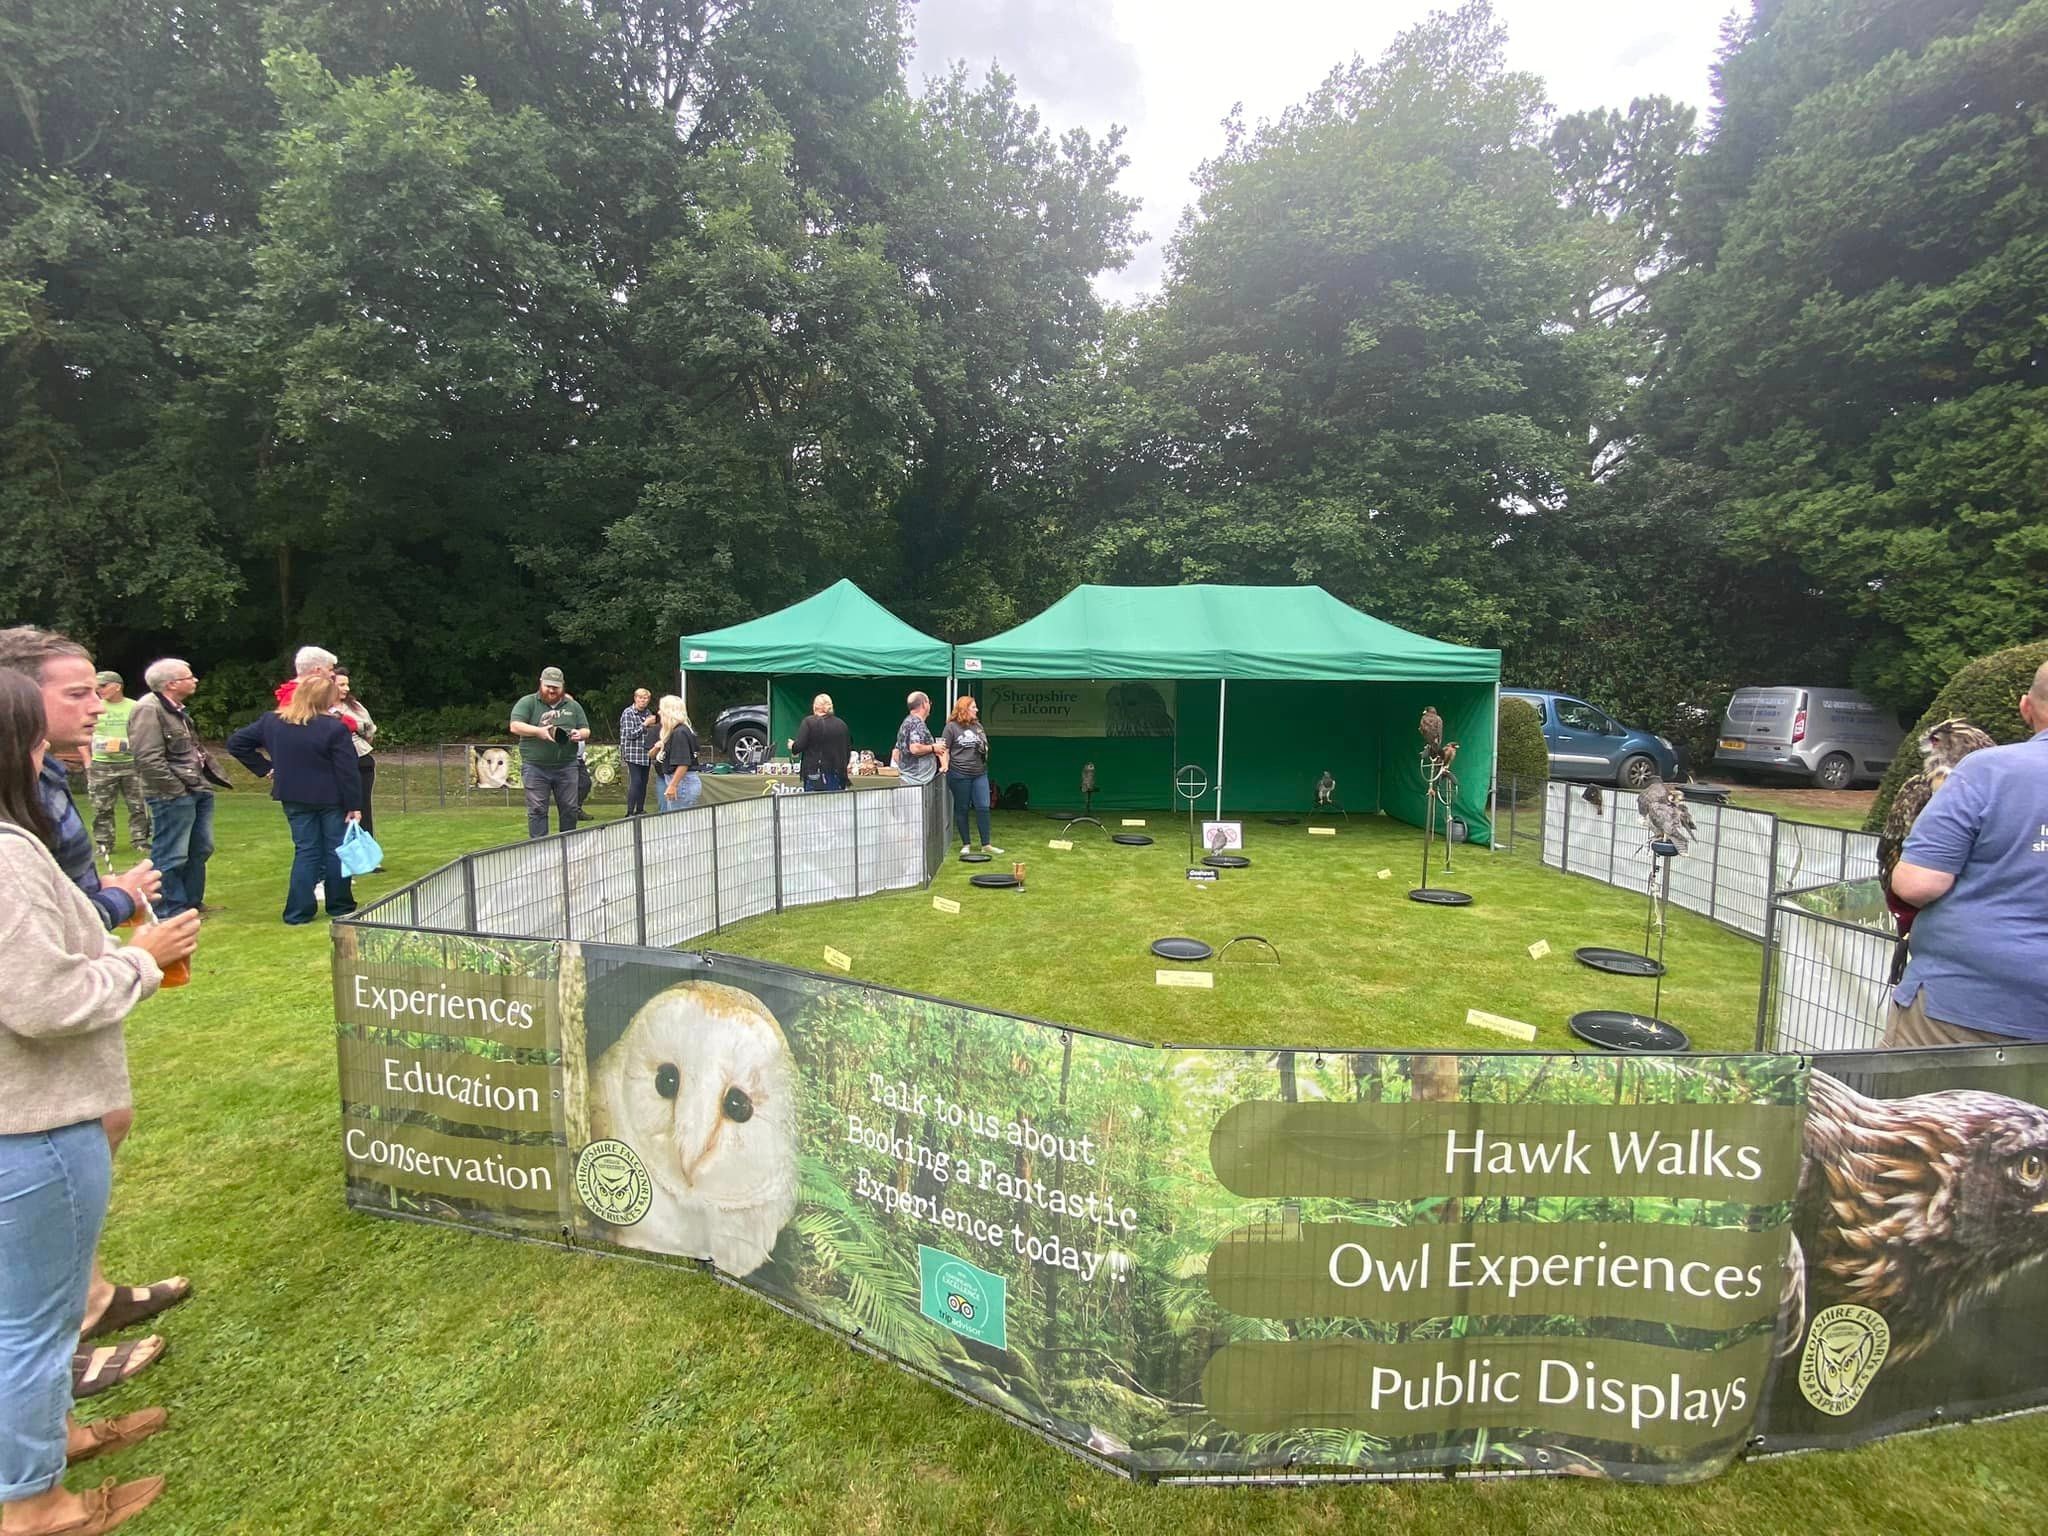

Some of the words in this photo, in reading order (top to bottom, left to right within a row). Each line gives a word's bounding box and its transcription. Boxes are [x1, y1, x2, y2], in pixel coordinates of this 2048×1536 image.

[1002, 689, 1079, 704] Shropshire
[1011, 703, 1072, 717] Falconry
[771, 782, 805, 795] Shro
[354, 974, 533, 1030] Experiences
[385, 1058, 540, 1112] Education
[868, 1072, 927, 1117] Talk
[934, 1094, 963, 1127] to
[967, 1110, 1000, 1139] us
[1008, 1118, 1096, 1166] about
[346, 1128, 553, 1192] Conservation
[578, 1143, 618, 1192] SHROPSHIRE
[620, 1147, 648, 1203] FALCONRY
[846, 1115, 950, 1183] Booking
[955, 1158, 970, 1185] a
[978, 1158, 1138, 1231] Fantastic
[1444, 1128, 1592, 1177] Hawk
[1608, 1127, 1763, 1182] Walks
[586, 1196, 642, 1223] EXPERIENCES
[855, 1166, 1004, 1247] Experience
[1011, 1224, 1103, 1283] today
[1327, 1241, 1431, 1293] Owl
[1447, 1240, 1763, 1300] Experiences
[938, 1309, 982, 1337] tripadvisor
[1803, 1307, 1855, 1382] SHROPSHIRE
[1856, 1309, 1887, 1366] FALCONRY
[1370, 1357, 1520, 1412] Public
[1537, 1359, 1748, 1430] Displays
[1809, 1373, 1870, 1412] EXPERIENCES
